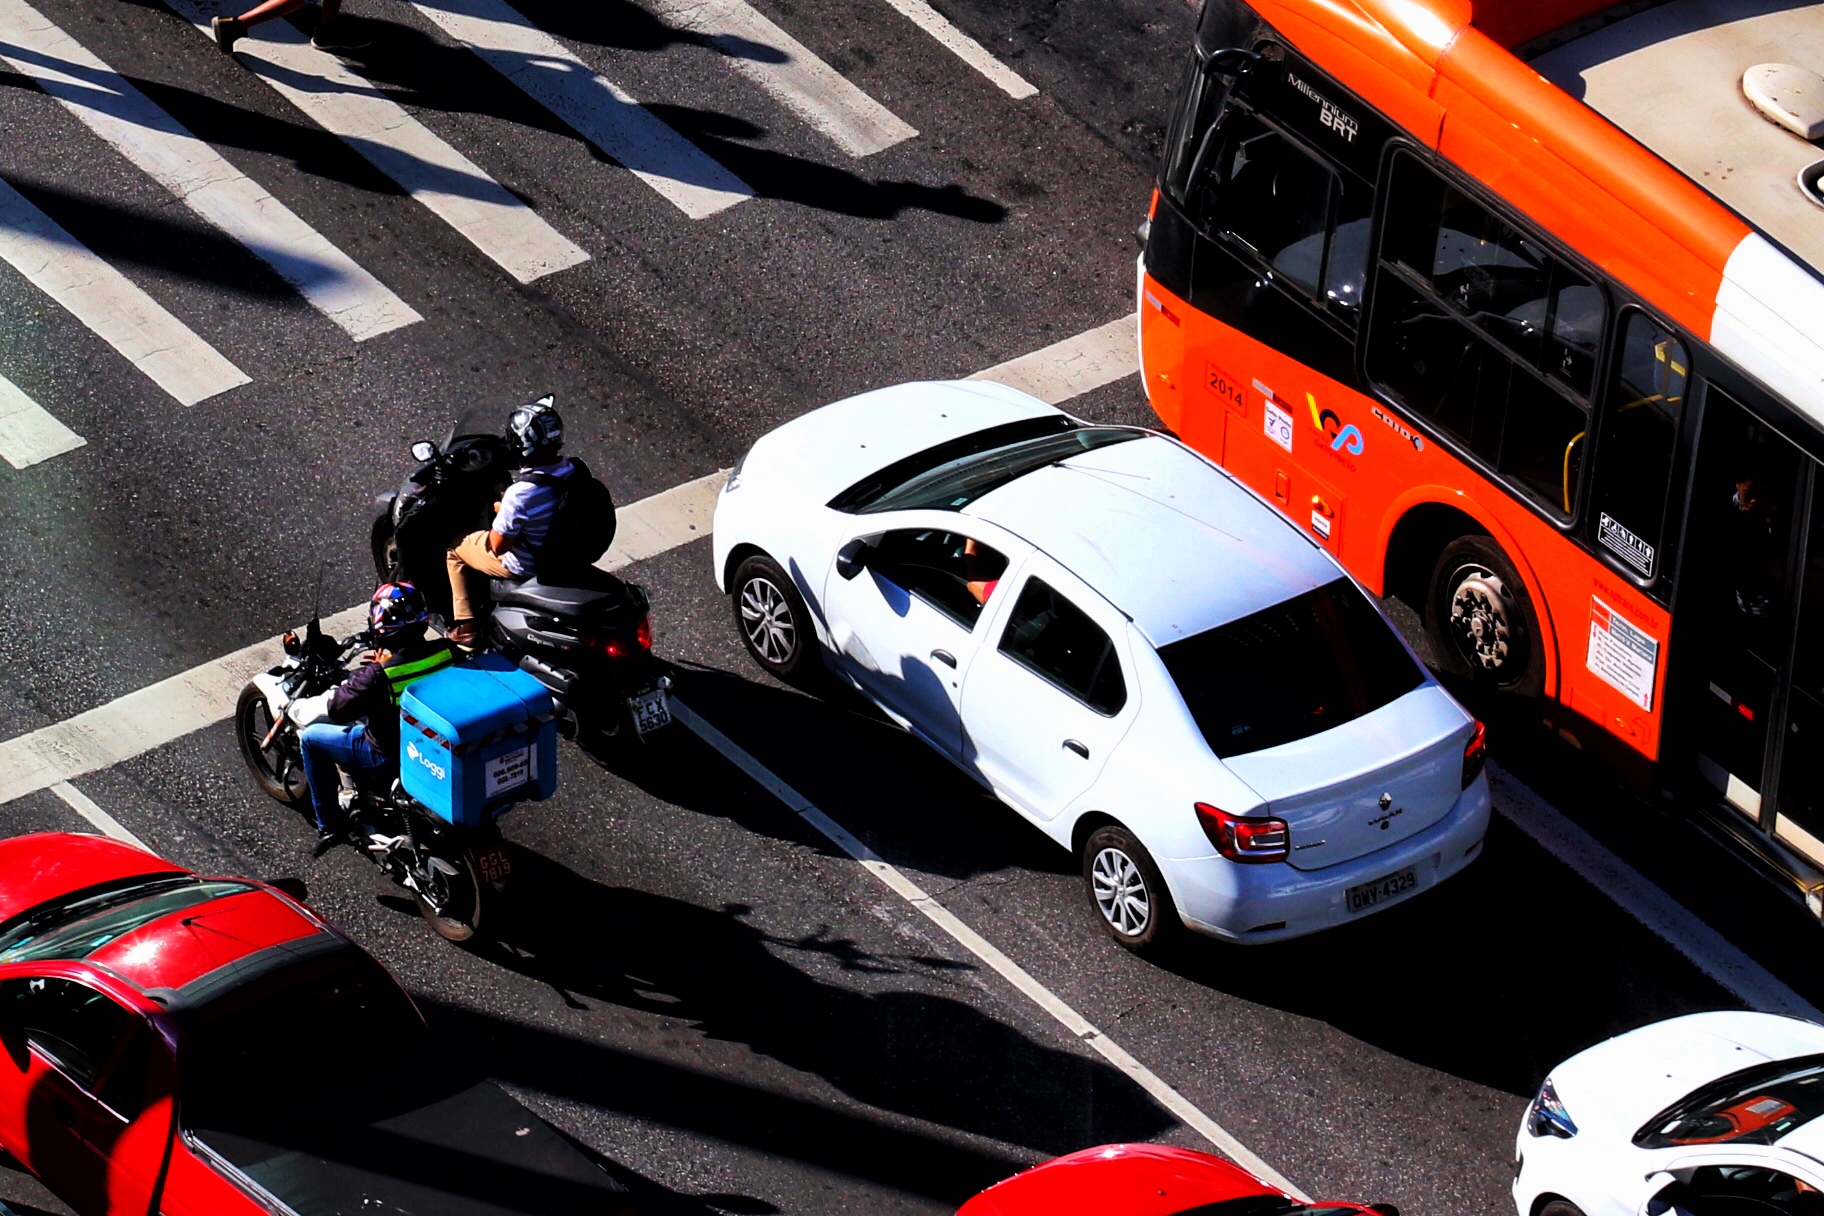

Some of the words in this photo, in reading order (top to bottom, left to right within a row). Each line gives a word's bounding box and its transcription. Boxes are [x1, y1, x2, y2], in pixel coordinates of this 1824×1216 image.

[1288, 73, 1358, 131] Millennium
[1319, 107, 1357, 143] BRT
[1210, 372, 1242, 406] 2014
[636, 698, 664, 719] FCX
[639, 710, 668, 733] 5630
[419, 752, 446, 781] Loggi
[480, 851, 508, 870] GGL
[482, 862, 511, 883] 7819
